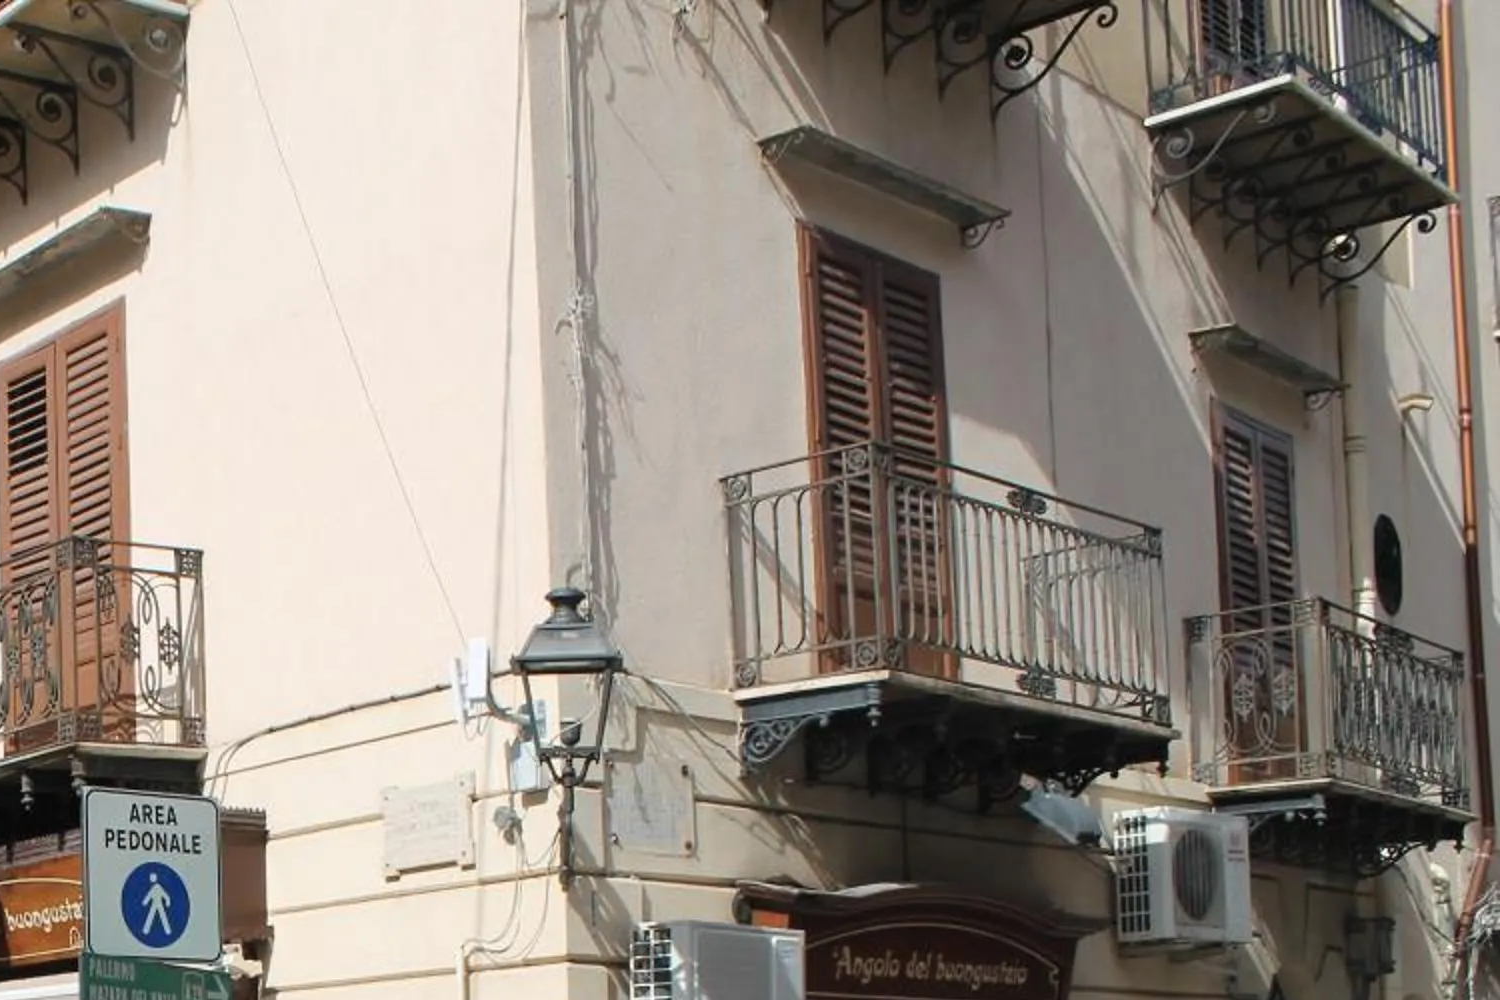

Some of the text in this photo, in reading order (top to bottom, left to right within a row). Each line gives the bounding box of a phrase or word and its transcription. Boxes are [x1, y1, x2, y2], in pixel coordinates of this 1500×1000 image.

[129, 803, 178, 826] AREA
[104, 828, 203, 855] PEDONALE
[4, 894, 84, 932] buongustai
[88, 957, 136, 982] PALERMO
[905, 950, 933, 980] del
[935, 952, 1028, 991] buongustaio
